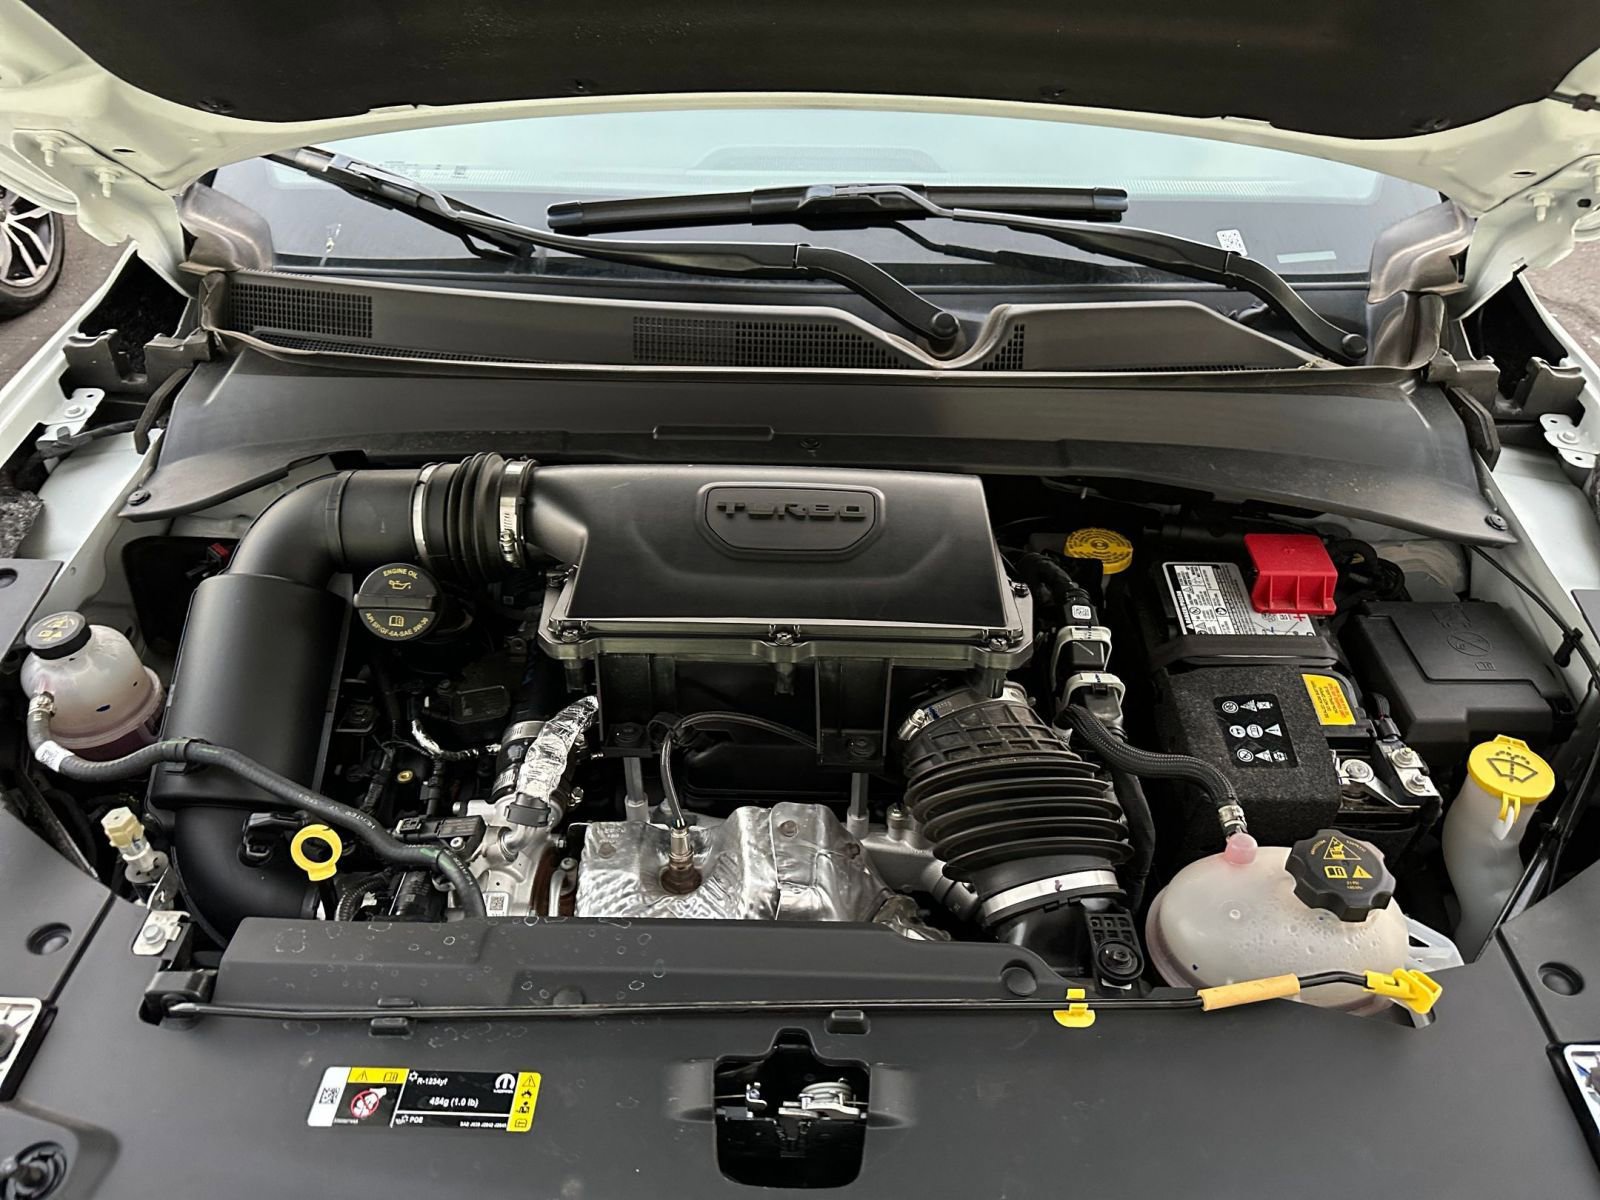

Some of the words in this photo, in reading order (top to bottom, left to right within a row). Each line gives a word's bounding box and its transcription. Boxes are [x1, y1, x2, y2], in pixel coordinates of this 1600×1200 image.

[716, 502, 866, 521] TURBO
[382, 567, 407, 577] ENGINE
[408, 570, 418, 579] OIL
[416, 1077, 448, 1087] R-1234yf
[450, 1097, 466, 1108] (1.0
[467, 1097, 479, 1108] lb)
